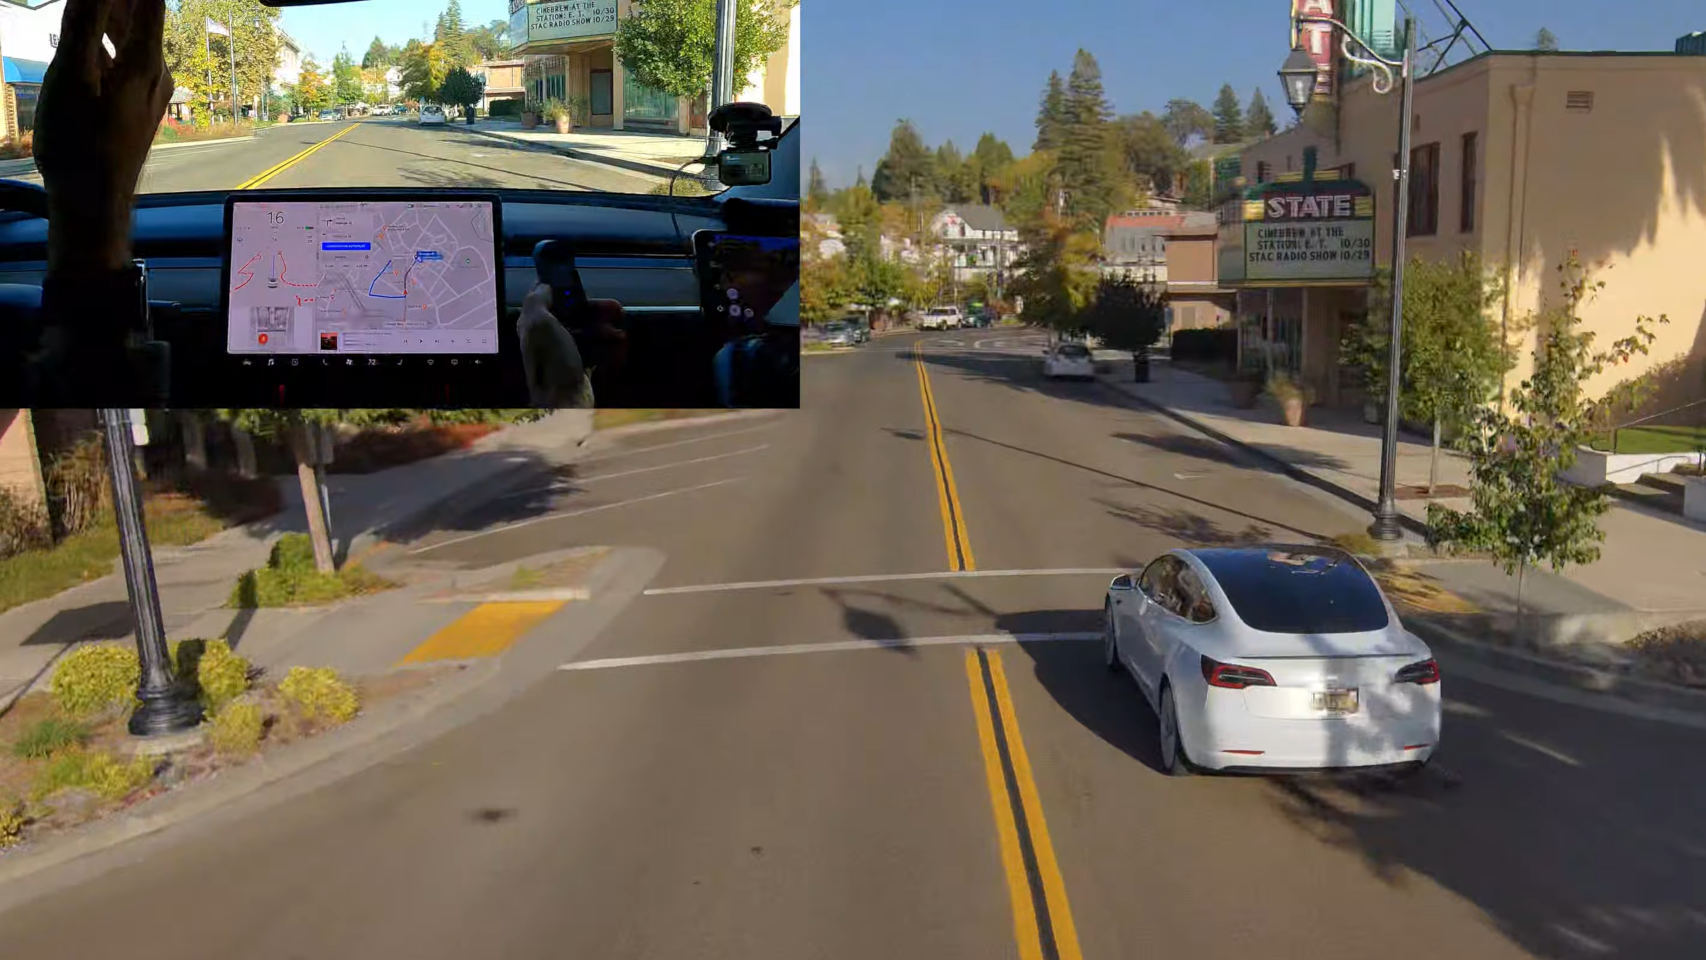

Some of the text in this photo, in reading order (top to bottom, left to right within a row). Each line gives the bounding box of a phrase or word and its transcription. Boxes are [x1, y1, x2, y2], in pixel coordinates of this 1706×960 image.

[583, 1, 595, 9] THE
[592, 7, 615, 15] 10/30
[531, 15, 615, 30] STAC RADIO SHOW 10/29
[1268, 194, 1351, 218] STATE
[267, 211, 284, 224] 16
[1326, 226, 1344, 236] THE
[1340, 238, 1370, 249] 10/30
[1249, 250, 1370, 262] STAC RADIO SHOW 10/29
